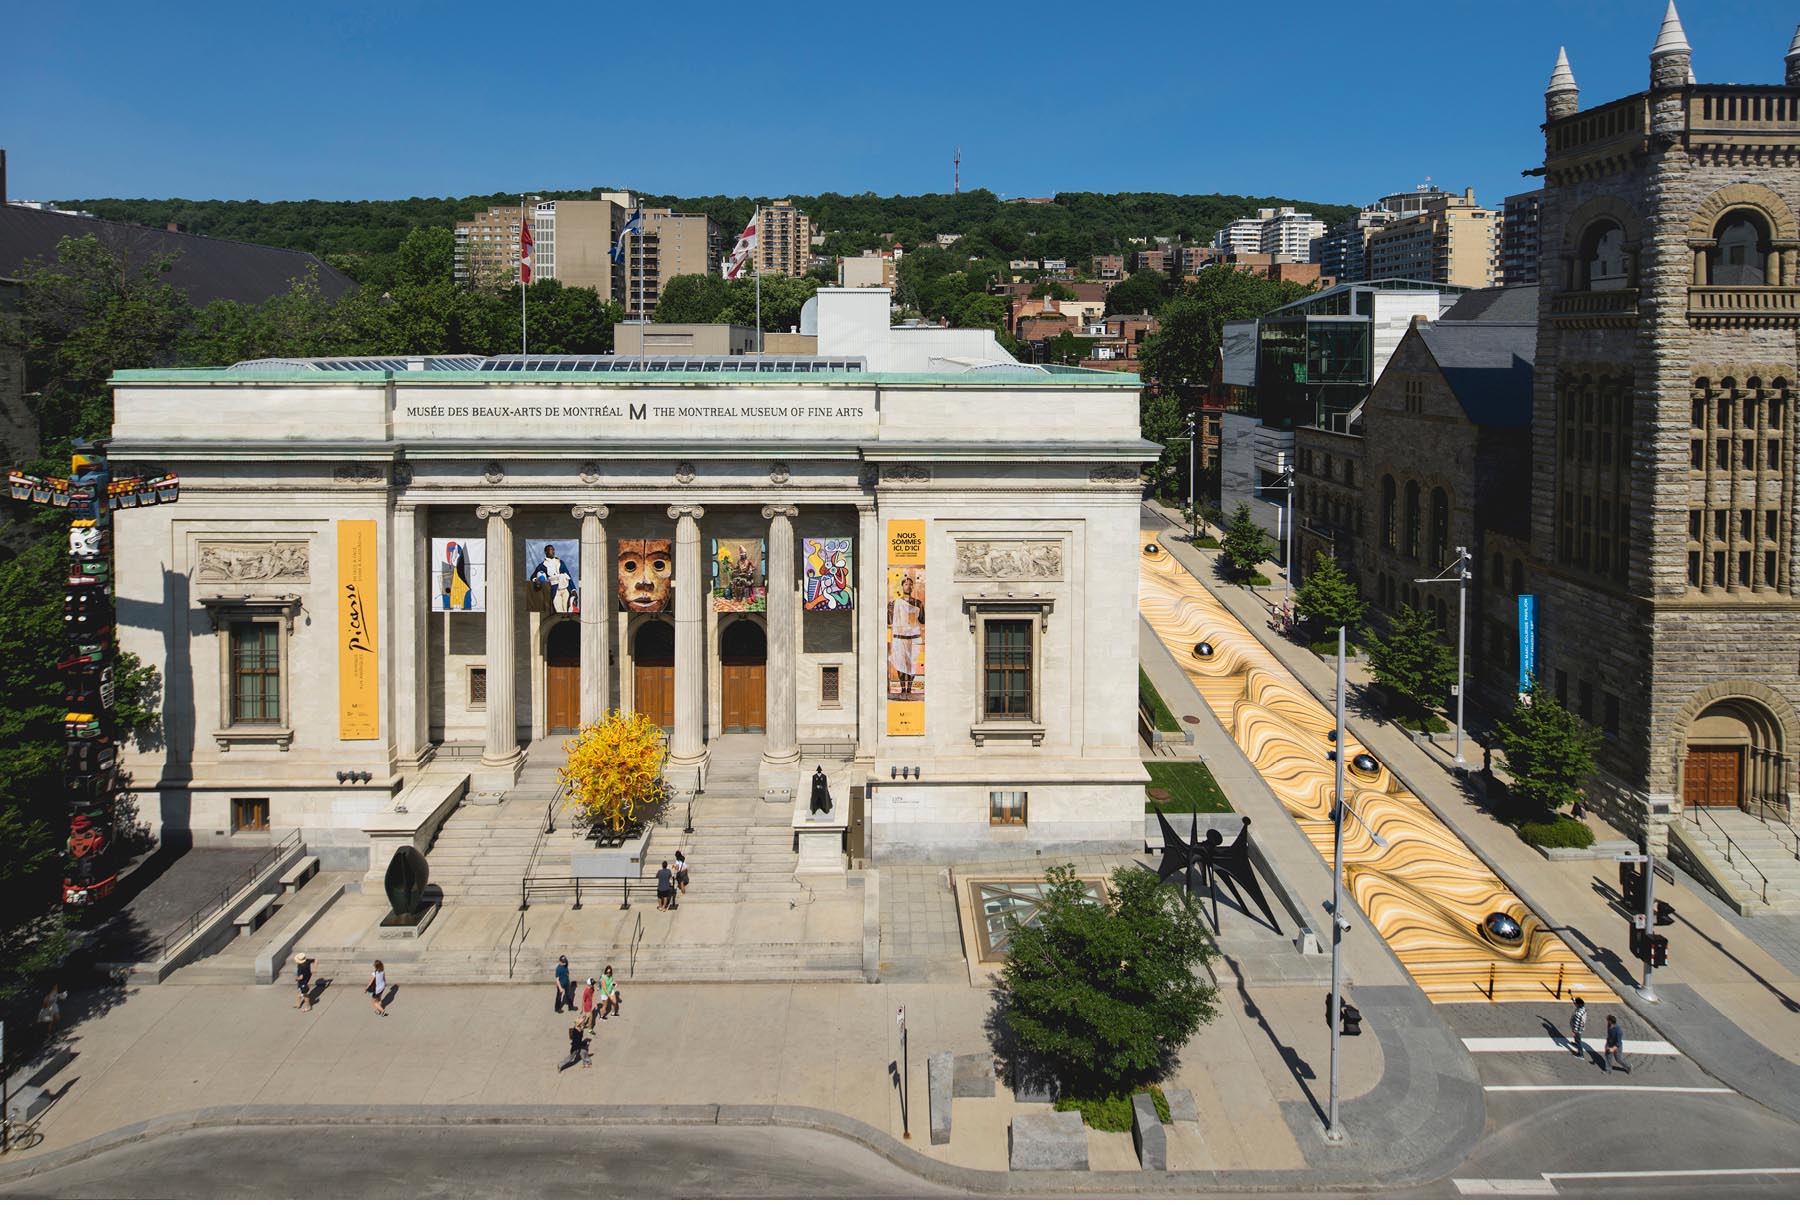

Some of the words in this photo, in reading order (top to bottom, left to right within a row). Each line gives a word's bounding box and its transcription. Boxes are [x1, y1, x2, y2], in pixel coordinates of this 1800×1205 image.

[407, 405, 445, 417] MUSÉE
[448, 407, 469, 417] DES
[472, 407, 542, 417] BEAUX-ARTS
[545, 407, 560, 417] DE
[563, 405, 623, 417] MONTRÉAL
[629, 403, 647, 420] M
[653, 407, 675, 417] THE
[678, 407, 738, 417] MONTREAL
[741, 407, 788, 417] MUSEUM
[790, 407, 805, 417] OF
[808, 407, 833, 417] FINE
[835, 407, 864, 417] ARTS
[346, 584, 375, 653] Picasso
